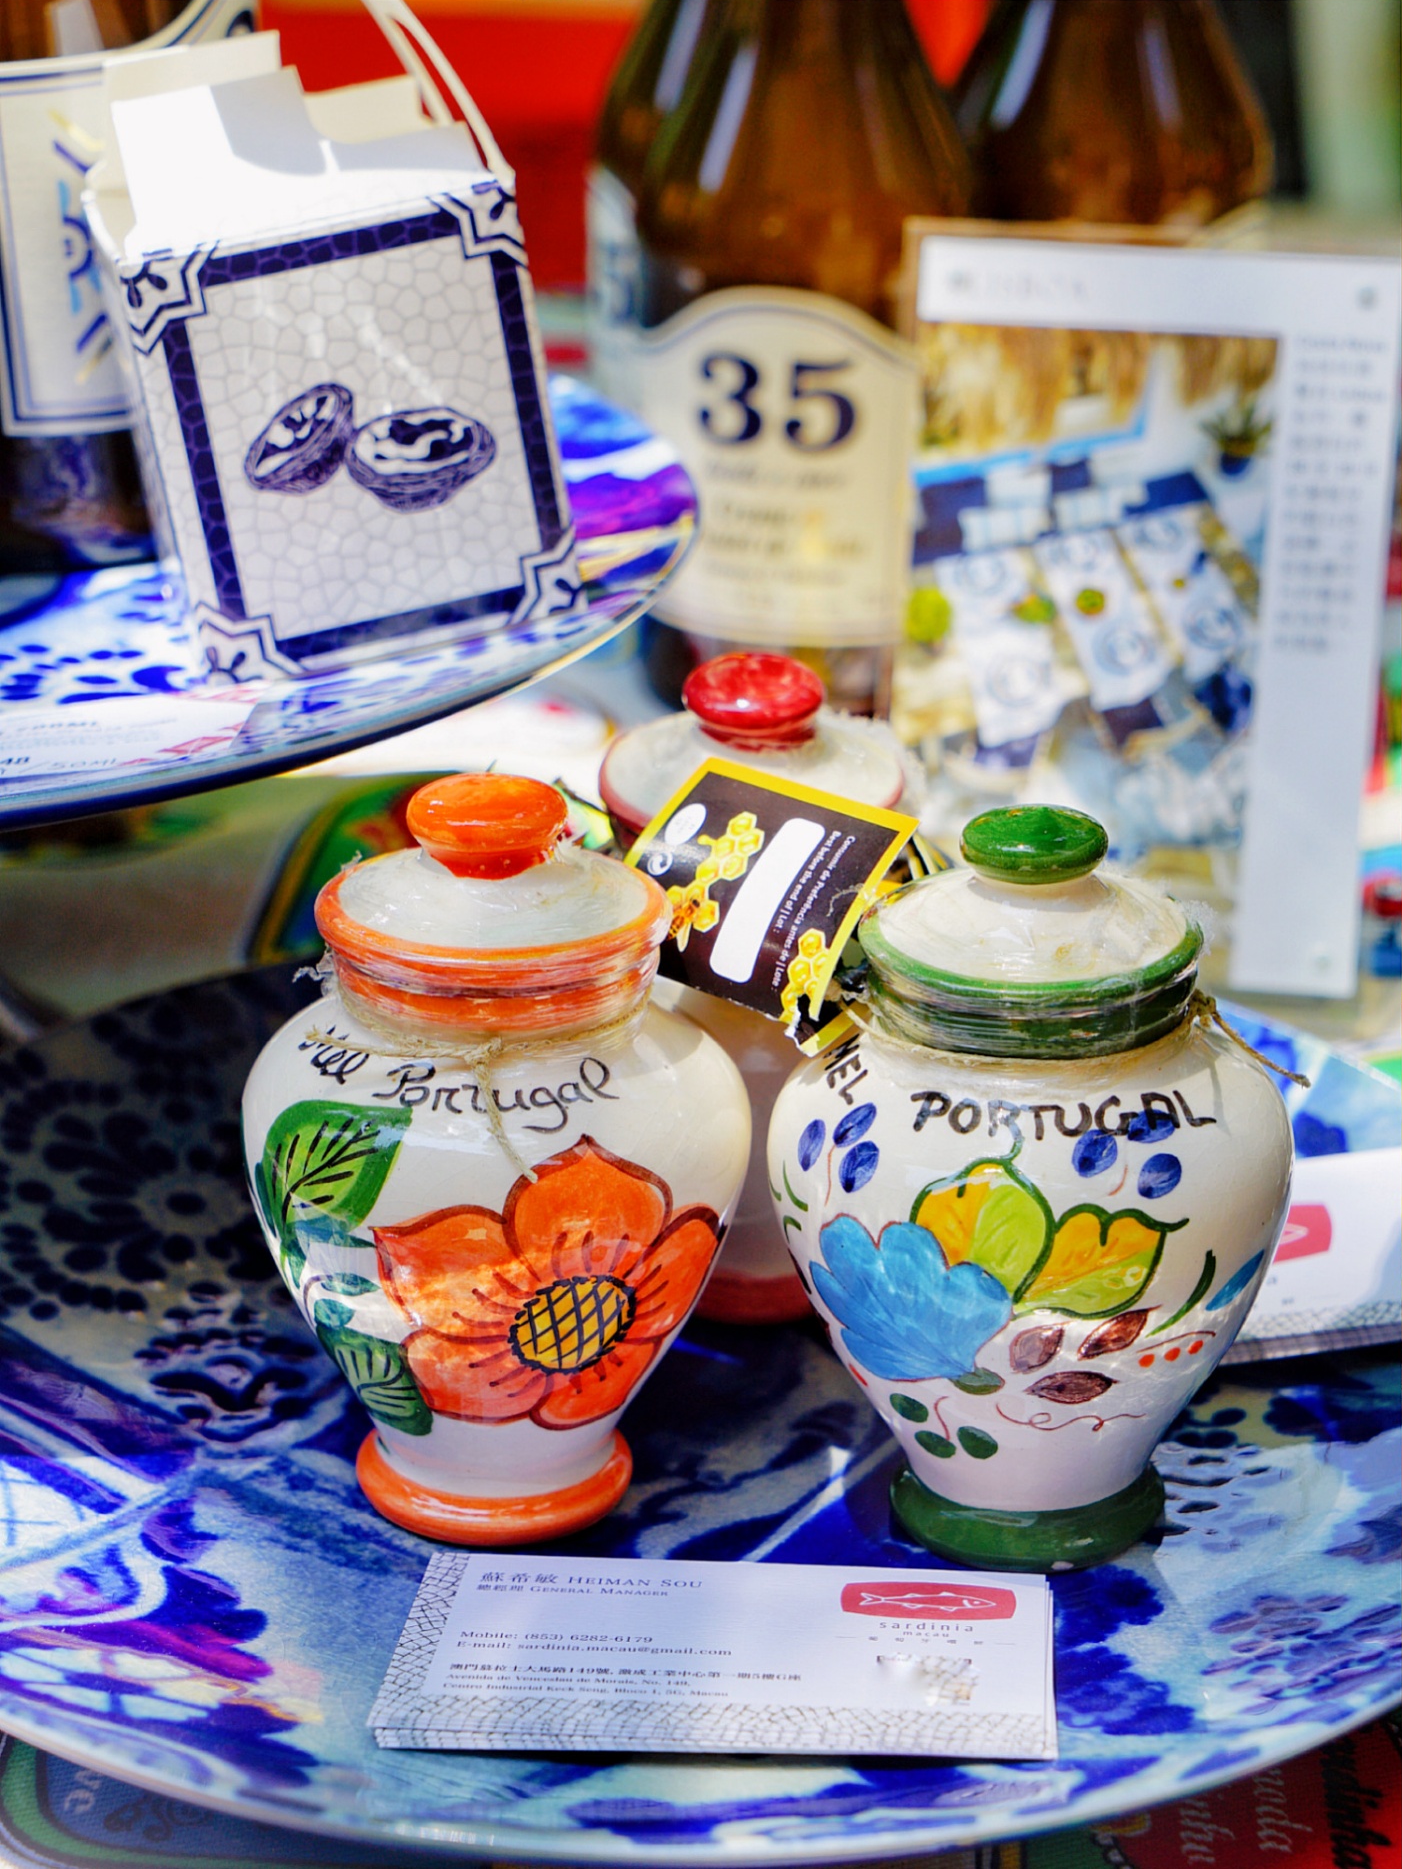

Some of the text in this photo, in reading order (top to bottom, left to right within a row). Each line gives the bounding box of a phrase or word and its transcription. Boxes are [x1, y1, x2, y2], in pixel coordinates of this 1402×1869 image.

[699, 350, 856, 453] 35
[371, 1056, 621, 1135] Portugal
[910, 1089, 1218, 1142] PORTUGAL
[567, 1575, 703, 1589] HEIMAN SOU
[459, 1630, 654, 1644] Mobile: (853) 6282-6179
[879, 1621, 974, 1632] sardinia
